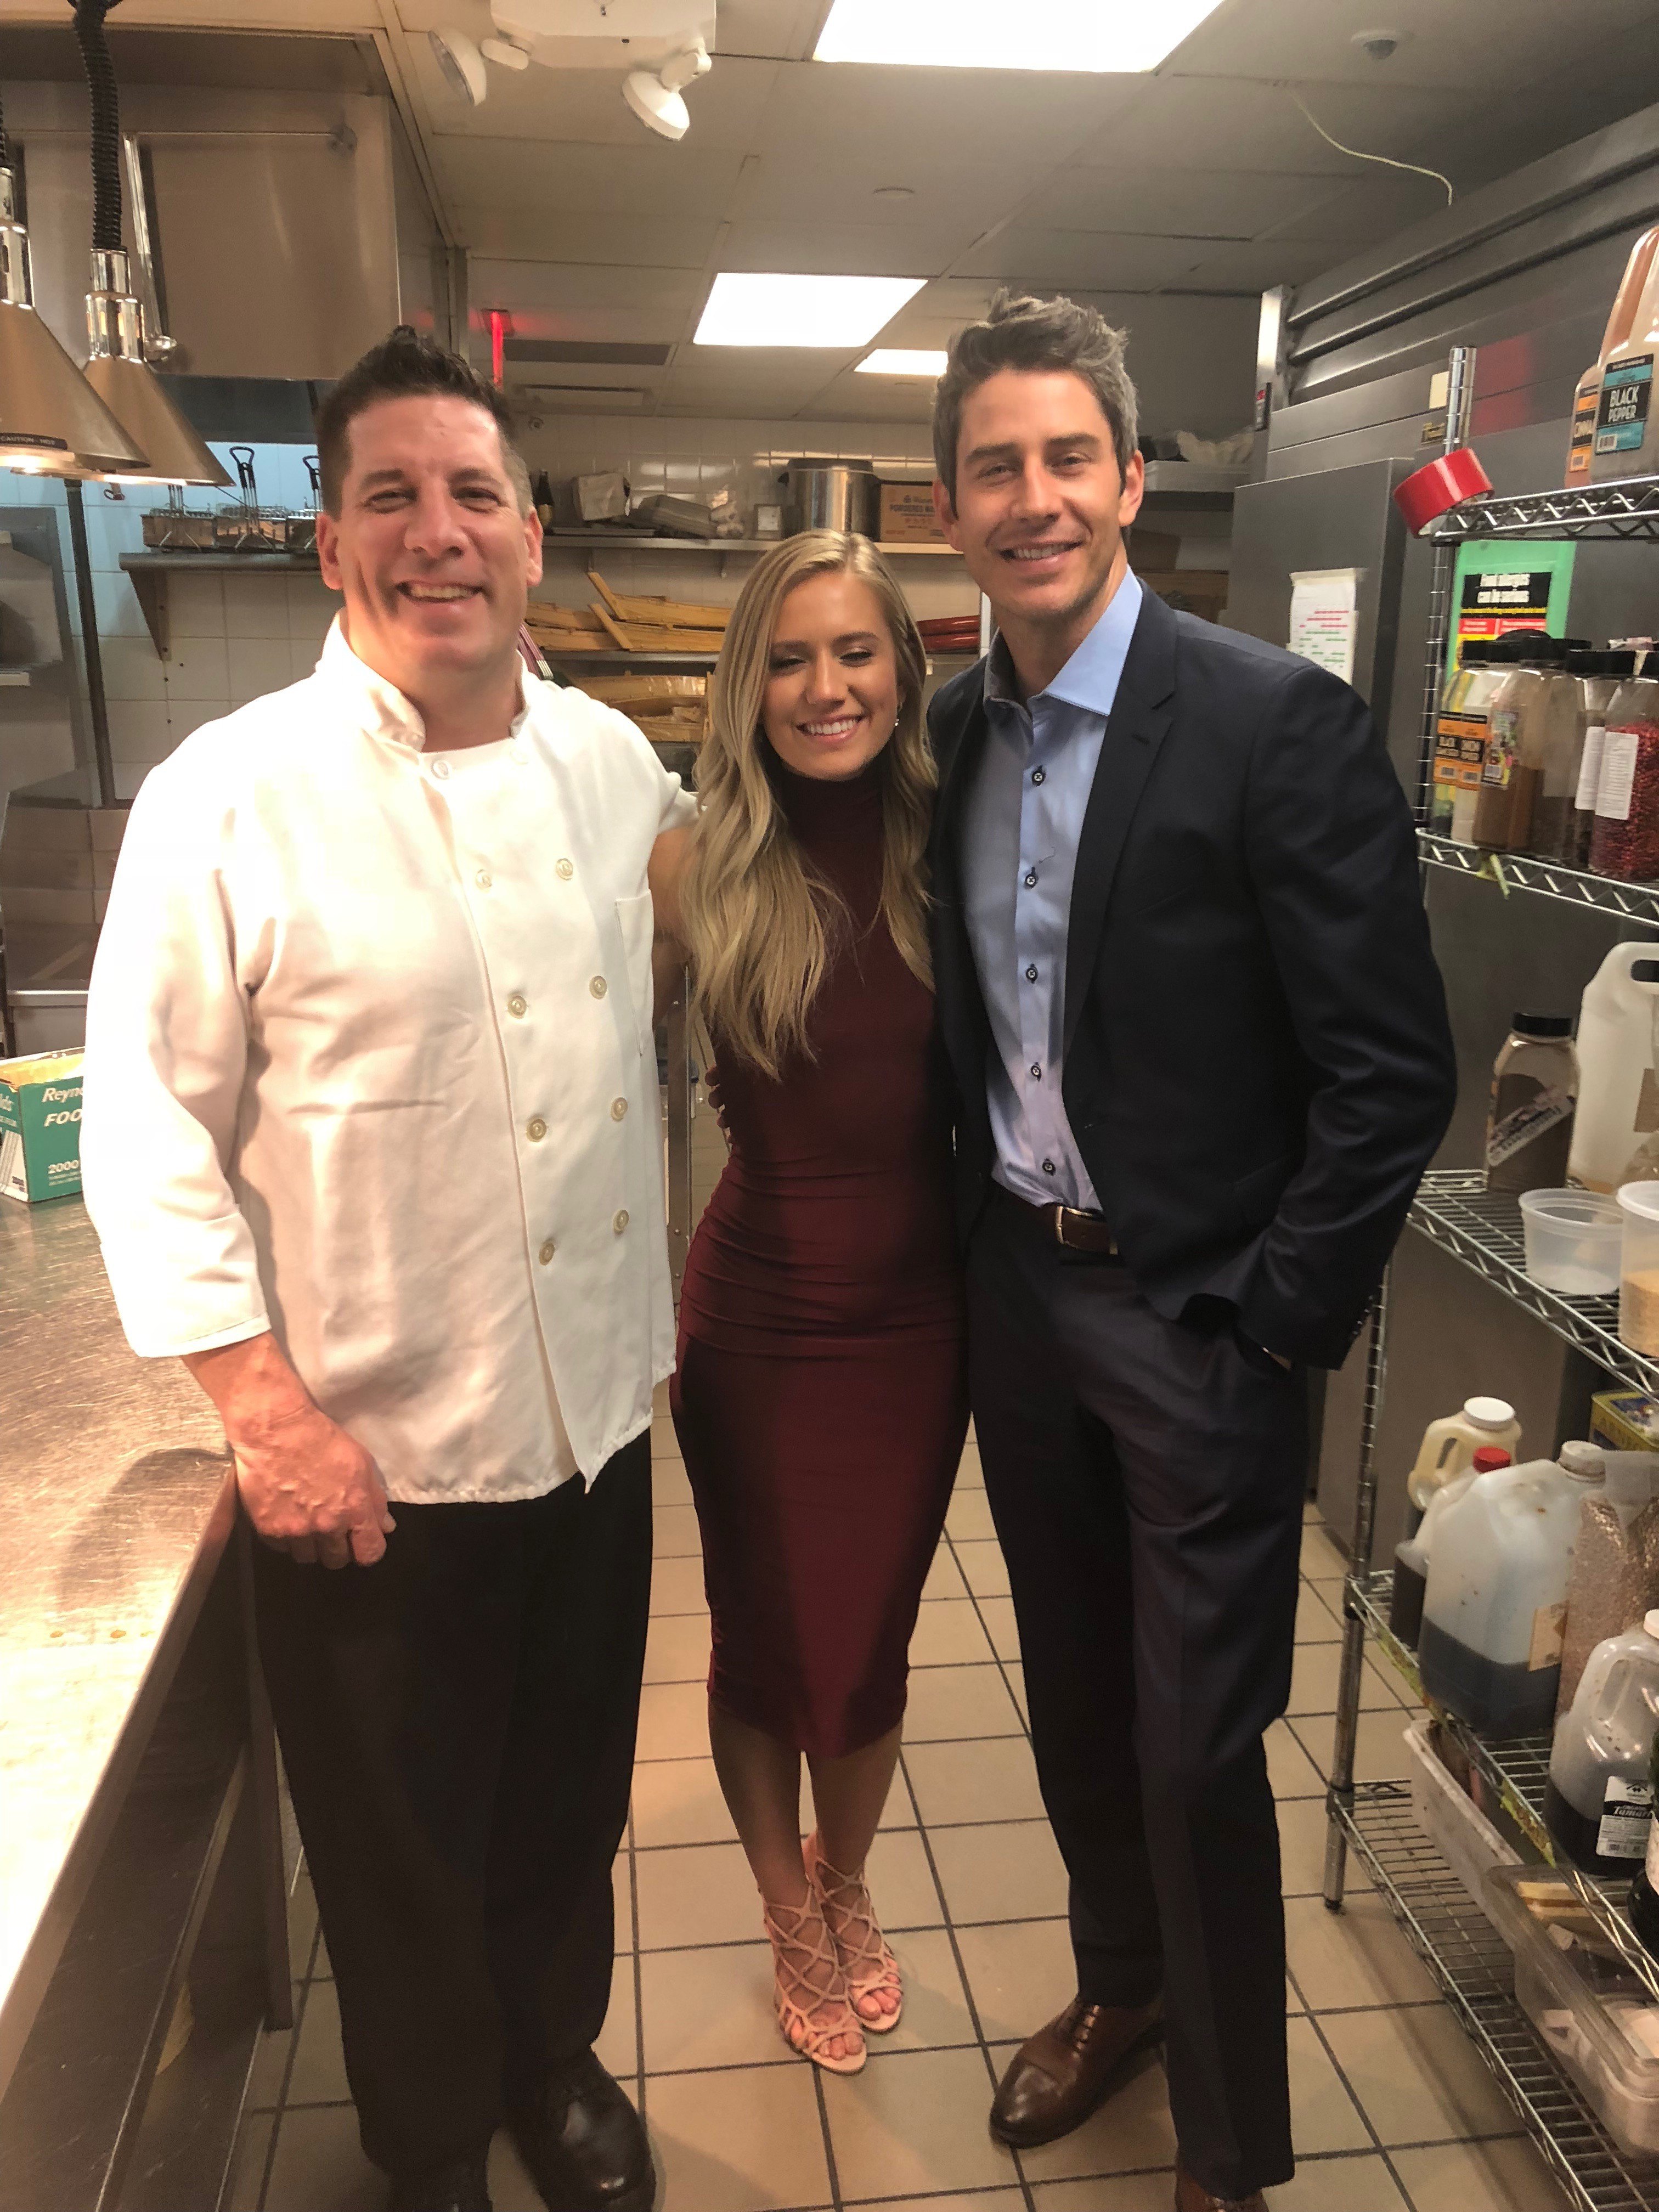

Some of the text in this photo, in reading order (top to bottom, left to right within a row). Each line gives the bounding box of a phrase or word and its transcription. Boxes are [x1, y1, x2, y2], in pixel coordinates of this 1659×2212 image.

[1610, 385, 1640, 407] BLACK
[1608, 405, 1637, 423] PEPPER
[47, 1159, 79, 1175] 2000
